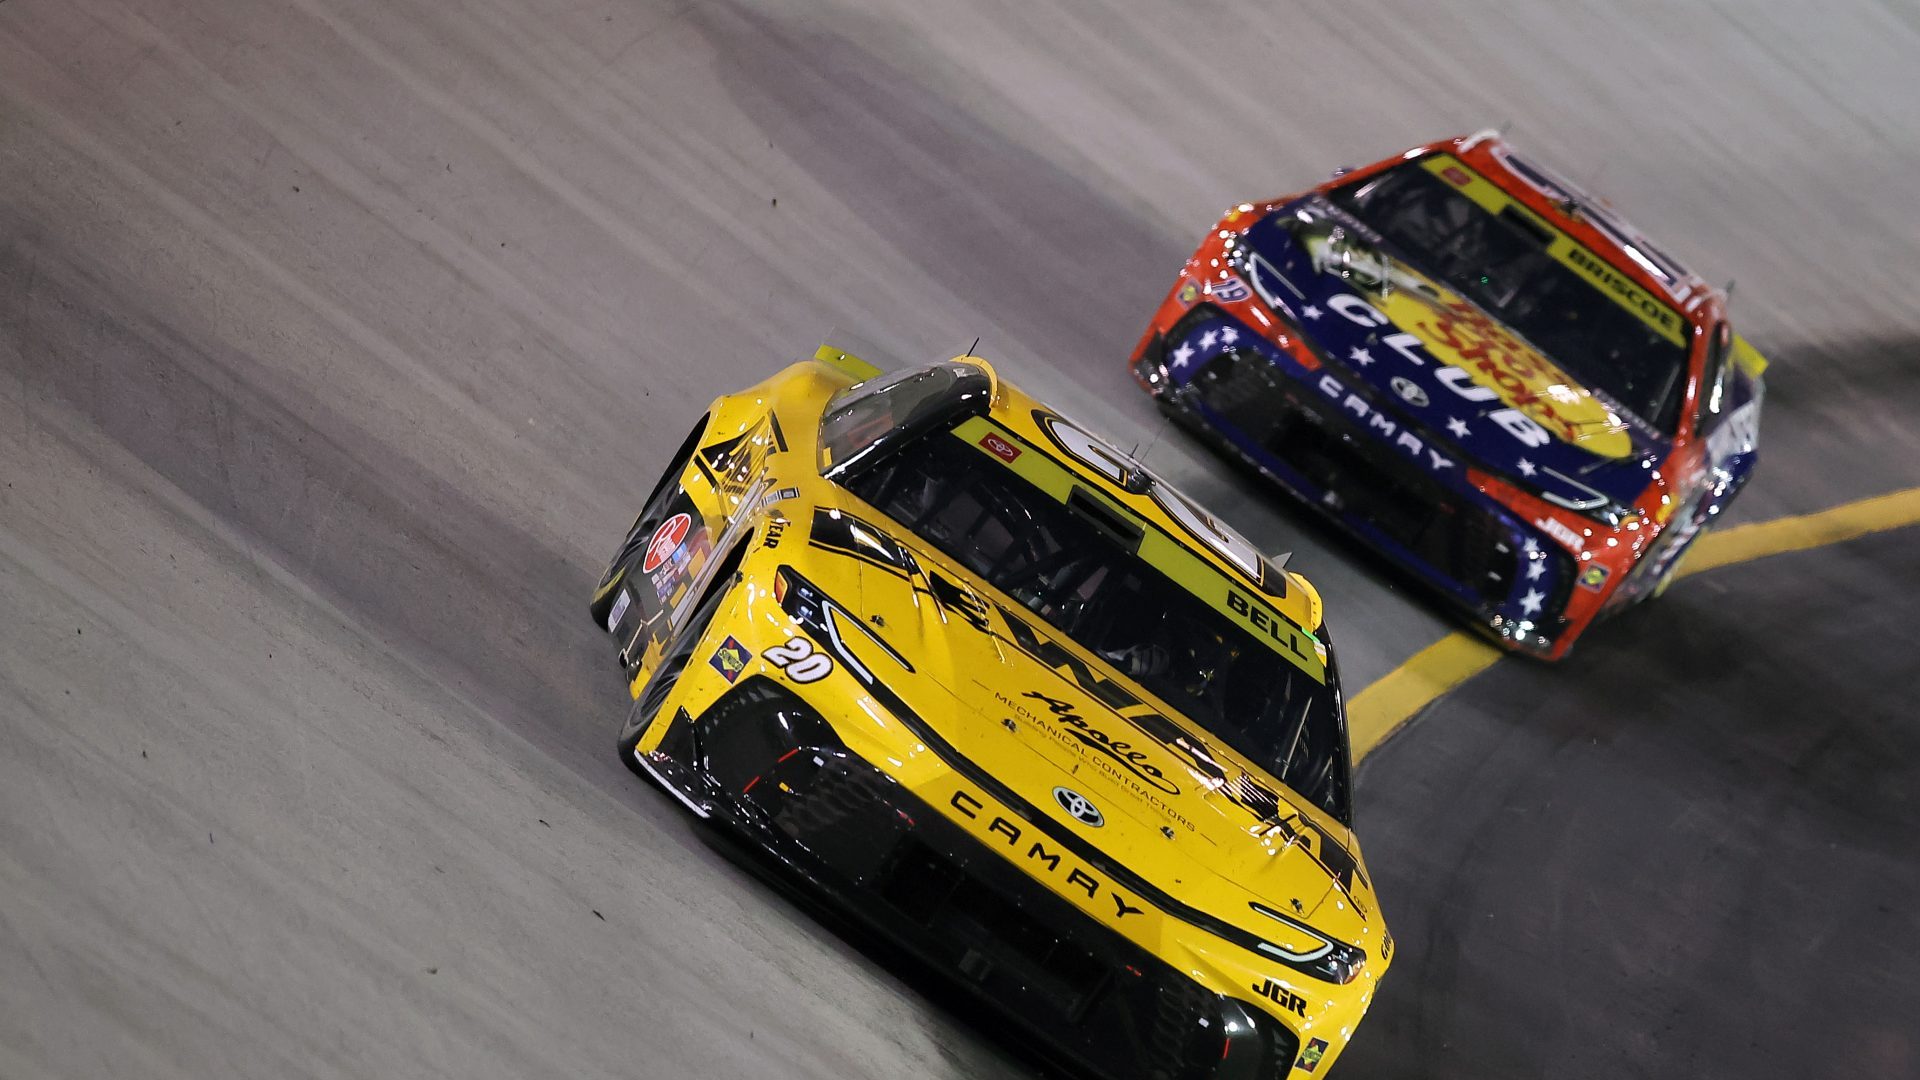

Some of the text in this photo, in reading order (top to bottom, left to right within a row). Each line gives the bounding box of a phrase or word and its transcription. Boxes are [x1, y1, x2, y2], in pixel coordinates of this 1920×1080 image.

[1207, 275, 1252, 303] 19
[1569, 248, 1675, 328] BRISCOE
[1327, 293, 1550, 448] CLUB
[1318, 375, 1455, 469] CAMRY
[761, 636, 833, 684] 20
[1226, 589, 1308, 662] BELL
[995, 692, 1195, 832] MECHANICAL CONTRACTORS
[1022, 691, 1180, 795] Apollo
[951, 790, 1144, 918] CAMRY
[1252, 979, 1307, 1018] JGR
